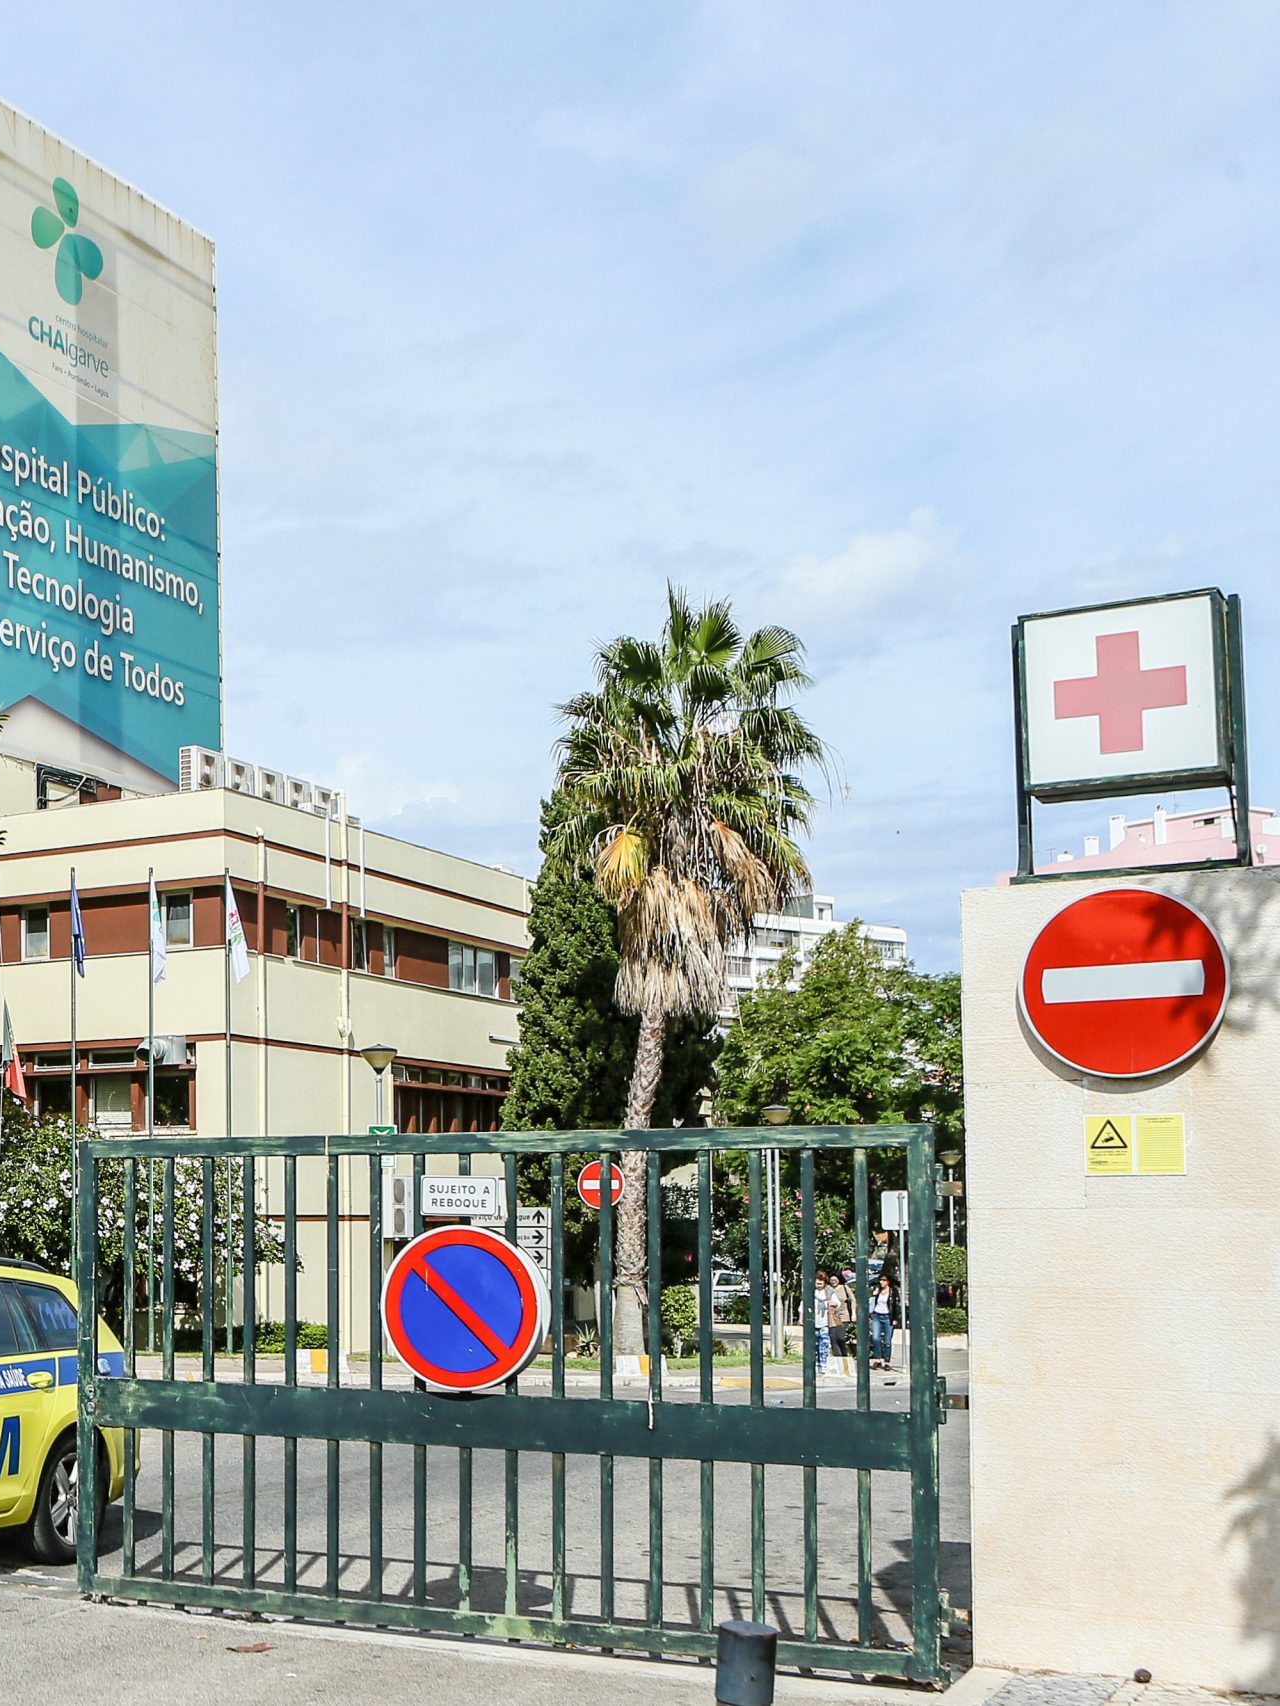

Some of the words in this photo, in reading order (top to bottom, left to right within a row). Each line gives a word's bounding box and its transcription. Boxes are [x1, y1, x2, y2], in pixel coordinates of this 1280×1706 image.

[28, 316, 109, 378] CHAlgarve
[77, 325, 108, 349] hospitalar
[52, 362, 64, 374] Faro
[94, 385, 110, 398] Lagos
[77, 469, 167, 541] Público:
[64, 519, 205, 615] Humanismo,
[2, 551, 134, 636] Tecnologia
[84, 640, 113, 681] de
[120, 651, 185, 706] Todos
[429, 1184, 476, 1194] SUJEITO
[483, 1185, 490, 1194] A
[431, 1198, 487, 1208] REBOQUE
[2, 1365, 28, 1389] SAÚDE
